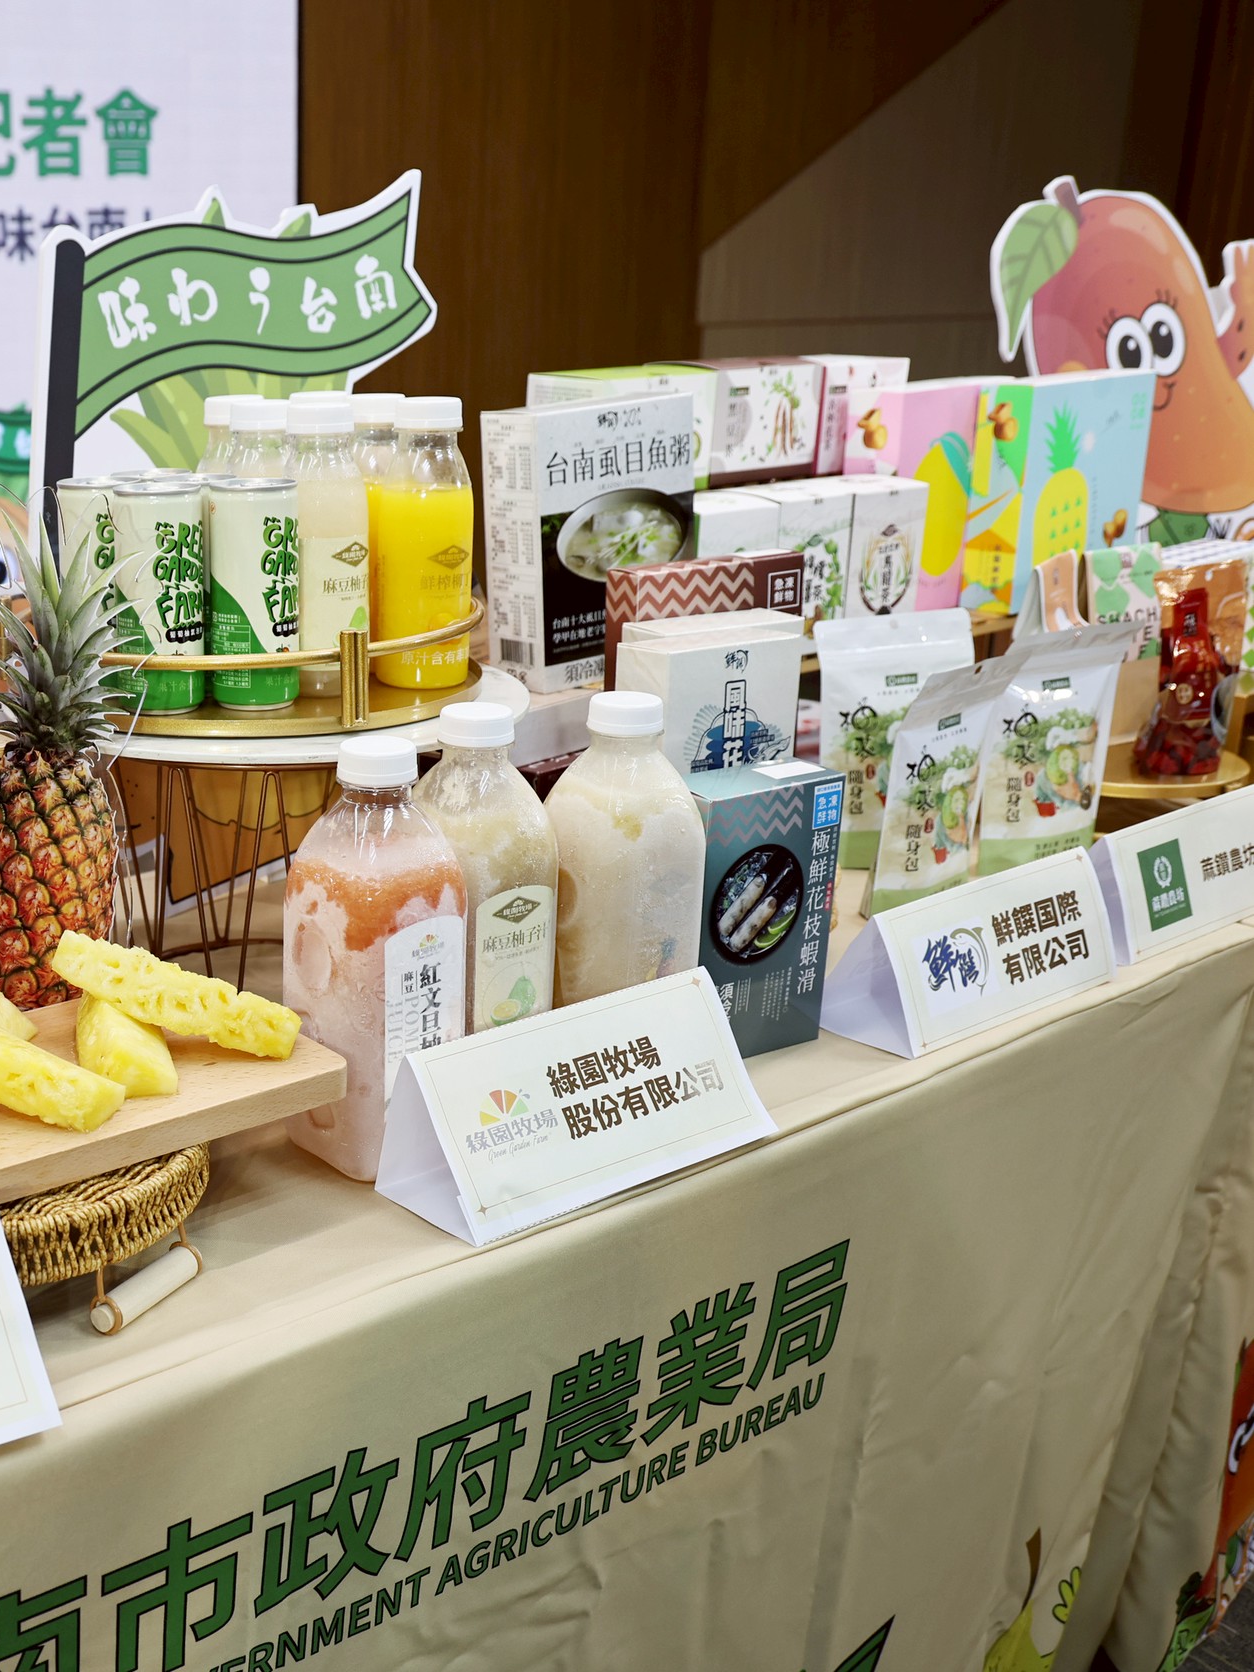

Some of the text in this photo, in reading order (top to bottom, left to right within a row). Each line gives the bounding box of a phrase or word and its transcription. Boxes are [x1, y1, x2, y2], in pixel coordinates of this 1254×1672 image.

[97, 254, 397, 350] 味わう台南
[546, 434, 691, 486] 台南虱目魚粥
[1002, 929, 1089, 985] 有限公司
[546, 1036, 662, 1100] 綠園牧場
[561, 1059, 725, 1140] 股份有限公司
[466, 1109, 558, 1154] 綠園牧場
[435, 1451, 688, 1597] AGRICULTURE
[697, 1372, 826, 1463] BUREAU
